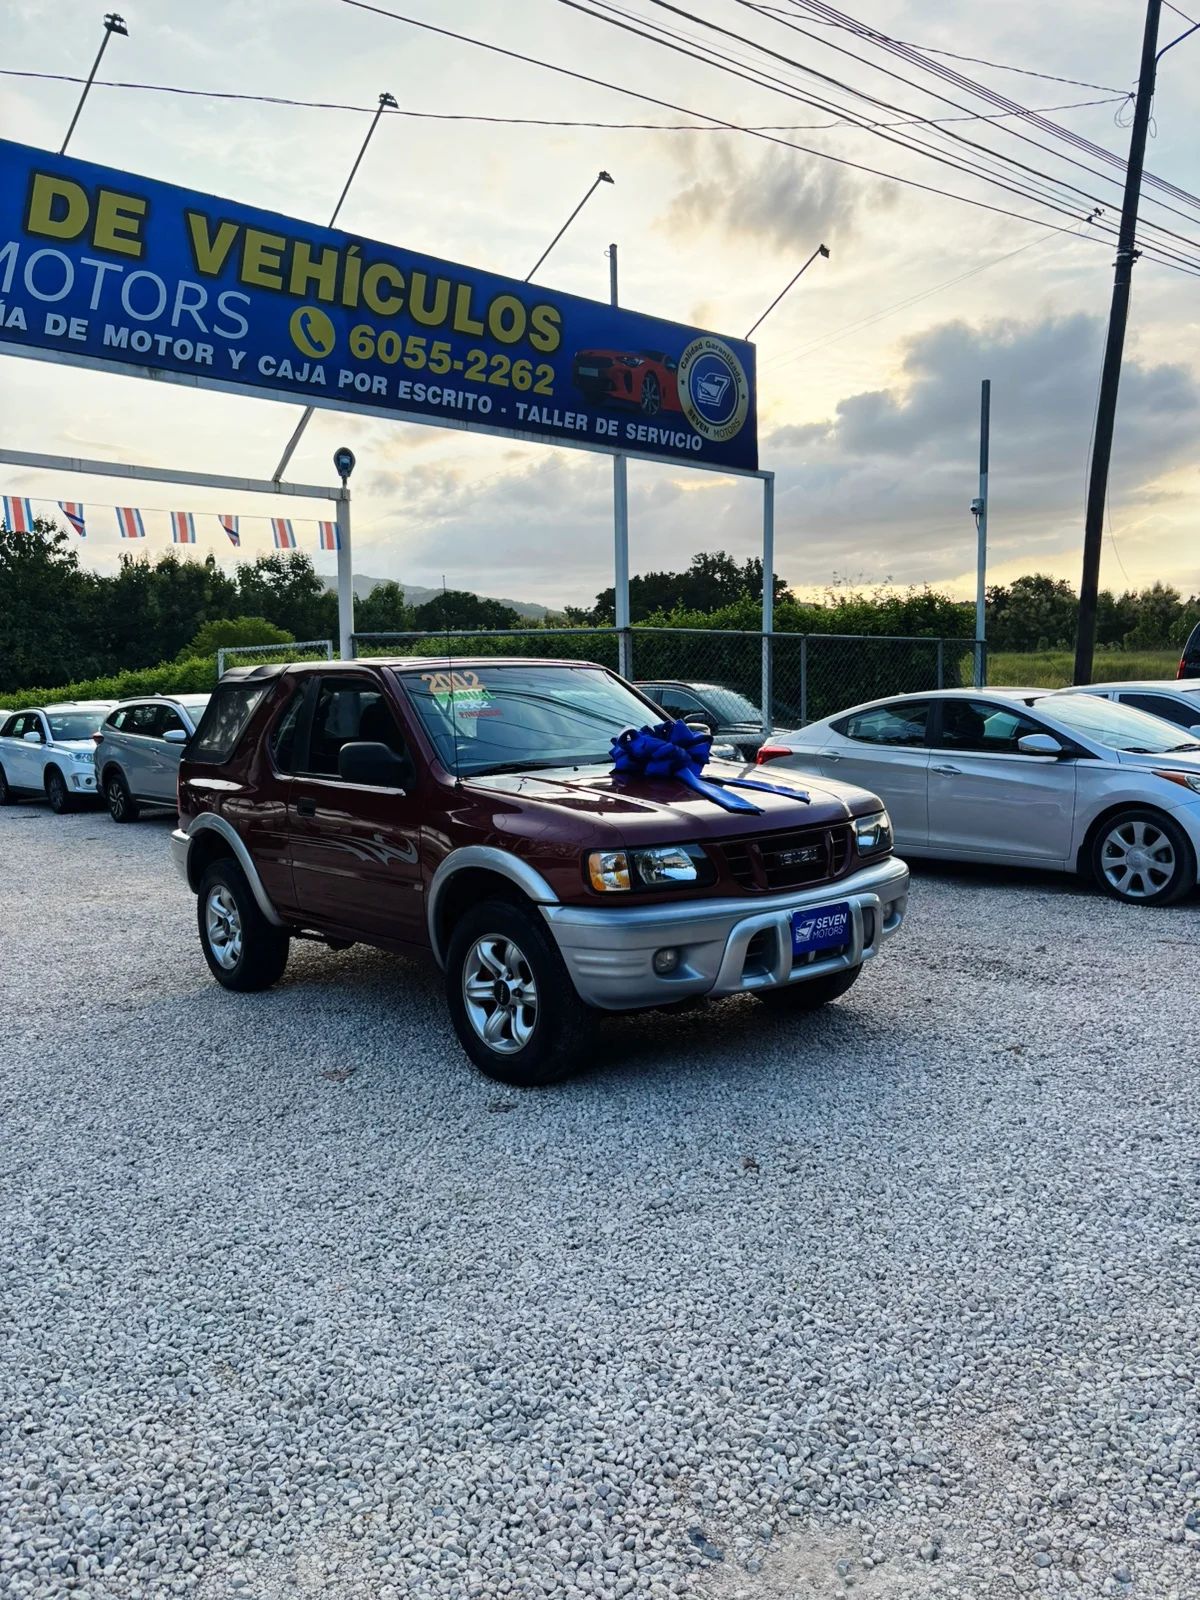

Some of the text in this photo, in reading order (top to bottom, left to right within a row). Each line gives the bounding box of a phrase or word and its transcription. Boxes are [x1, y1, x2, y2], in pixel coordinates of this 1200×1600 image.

[27, 173, 562, 352] DE VEHÍCULOS
[349, 324, 555, 396] 6055-2262
[681, 342, 703, 369] Calidad
[44, 313, 89, 341] DE
[103, 325, 214, 365] MOTOR
[228, 349, 247, 370] Y
[258, 355, 327, 385] CAJA
[338, 369, 388, 395] POR
[398, 380, 493, 414] ESCRITO
[516, 402, 588, 432] TALLER
[595, 418, 618, 437] DE
[626, 423, 703, 452] SERVICIO
[688, 408, 741, 439] SEVEN MOTORS
[421, 671, 487, 692] 2002
[780, 848, 817, 866] ISUZU
[812, 925, 844, 940] MOTORS
[816, 912, 847, 930] SEVEN
